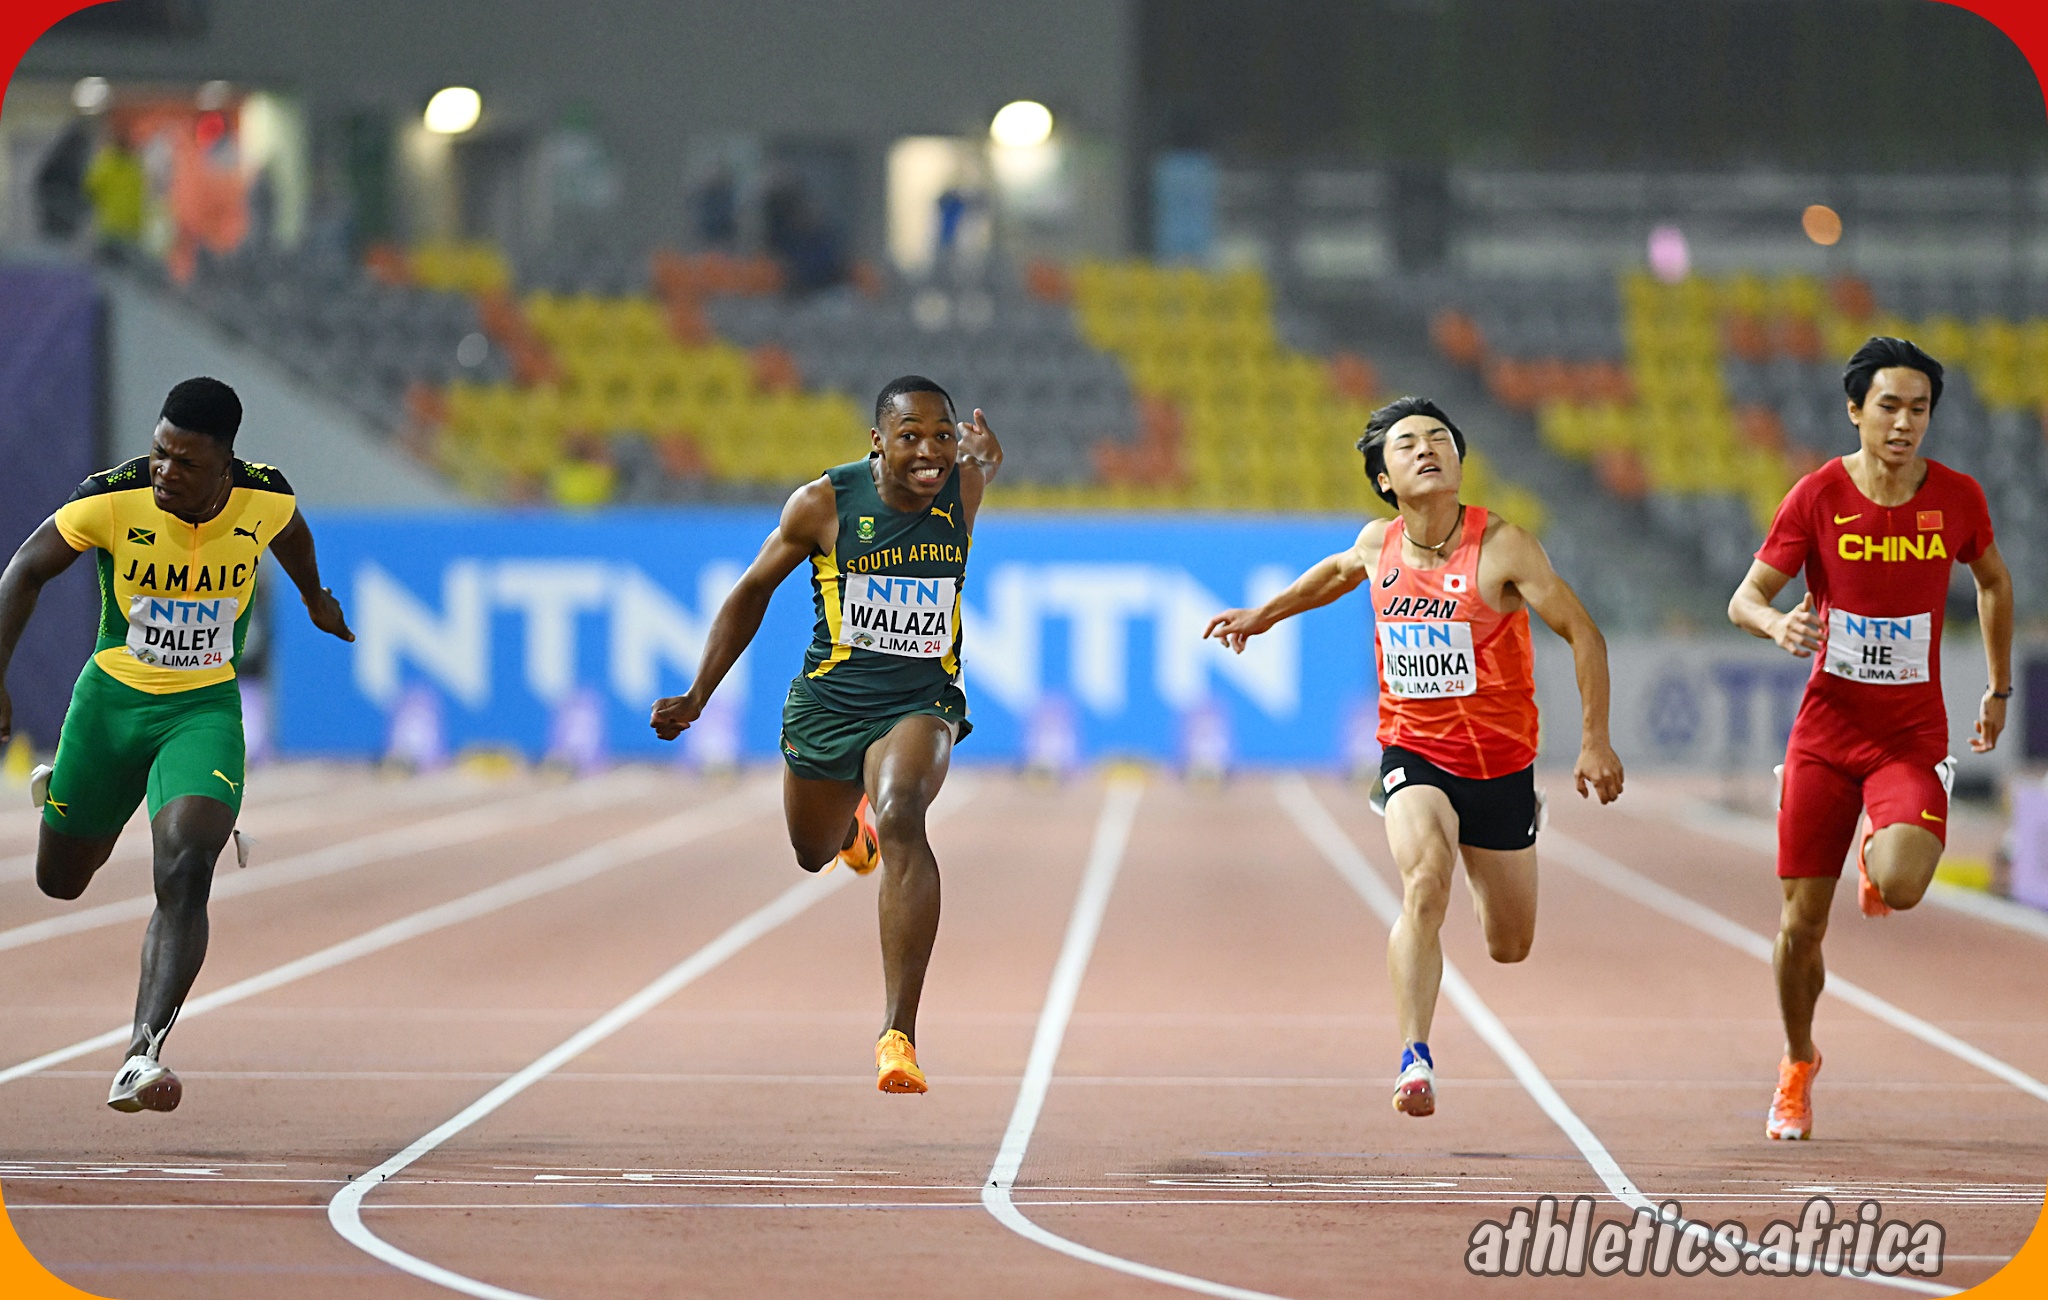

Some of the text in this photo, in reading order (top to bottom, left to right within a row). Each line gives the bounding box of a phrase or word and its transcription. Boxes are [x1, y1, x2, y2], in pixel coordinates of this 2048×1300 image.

[846, 543, 963, 573] SOUTH AFRICA
[1838, 533, 1947, 561] CHINA
[867, 577, 939, 605] NTN
[150, 599, 219, 623] NTN
[851, 604, 946, 636] WALAZA
[1382, 597, 1457, 619] JAPAN
[145, 626, 219, 651] DALEY
[353, 560, 750, 706] NTN
[1389, 624, 1451, 648] NTN
[1846, 616, 1912, 640] NTN
[879, 636, 941, 653] LIMA 24
[1862, 645, 1892, 665] HE
[161, 652, 222, 667] LIMA 24
[1387, 653, 1469, 677] NISHIOKA
[1858, 667, 1918, 680] LIMA 24
[1407, 680, 1465, 694] LIMA 24
